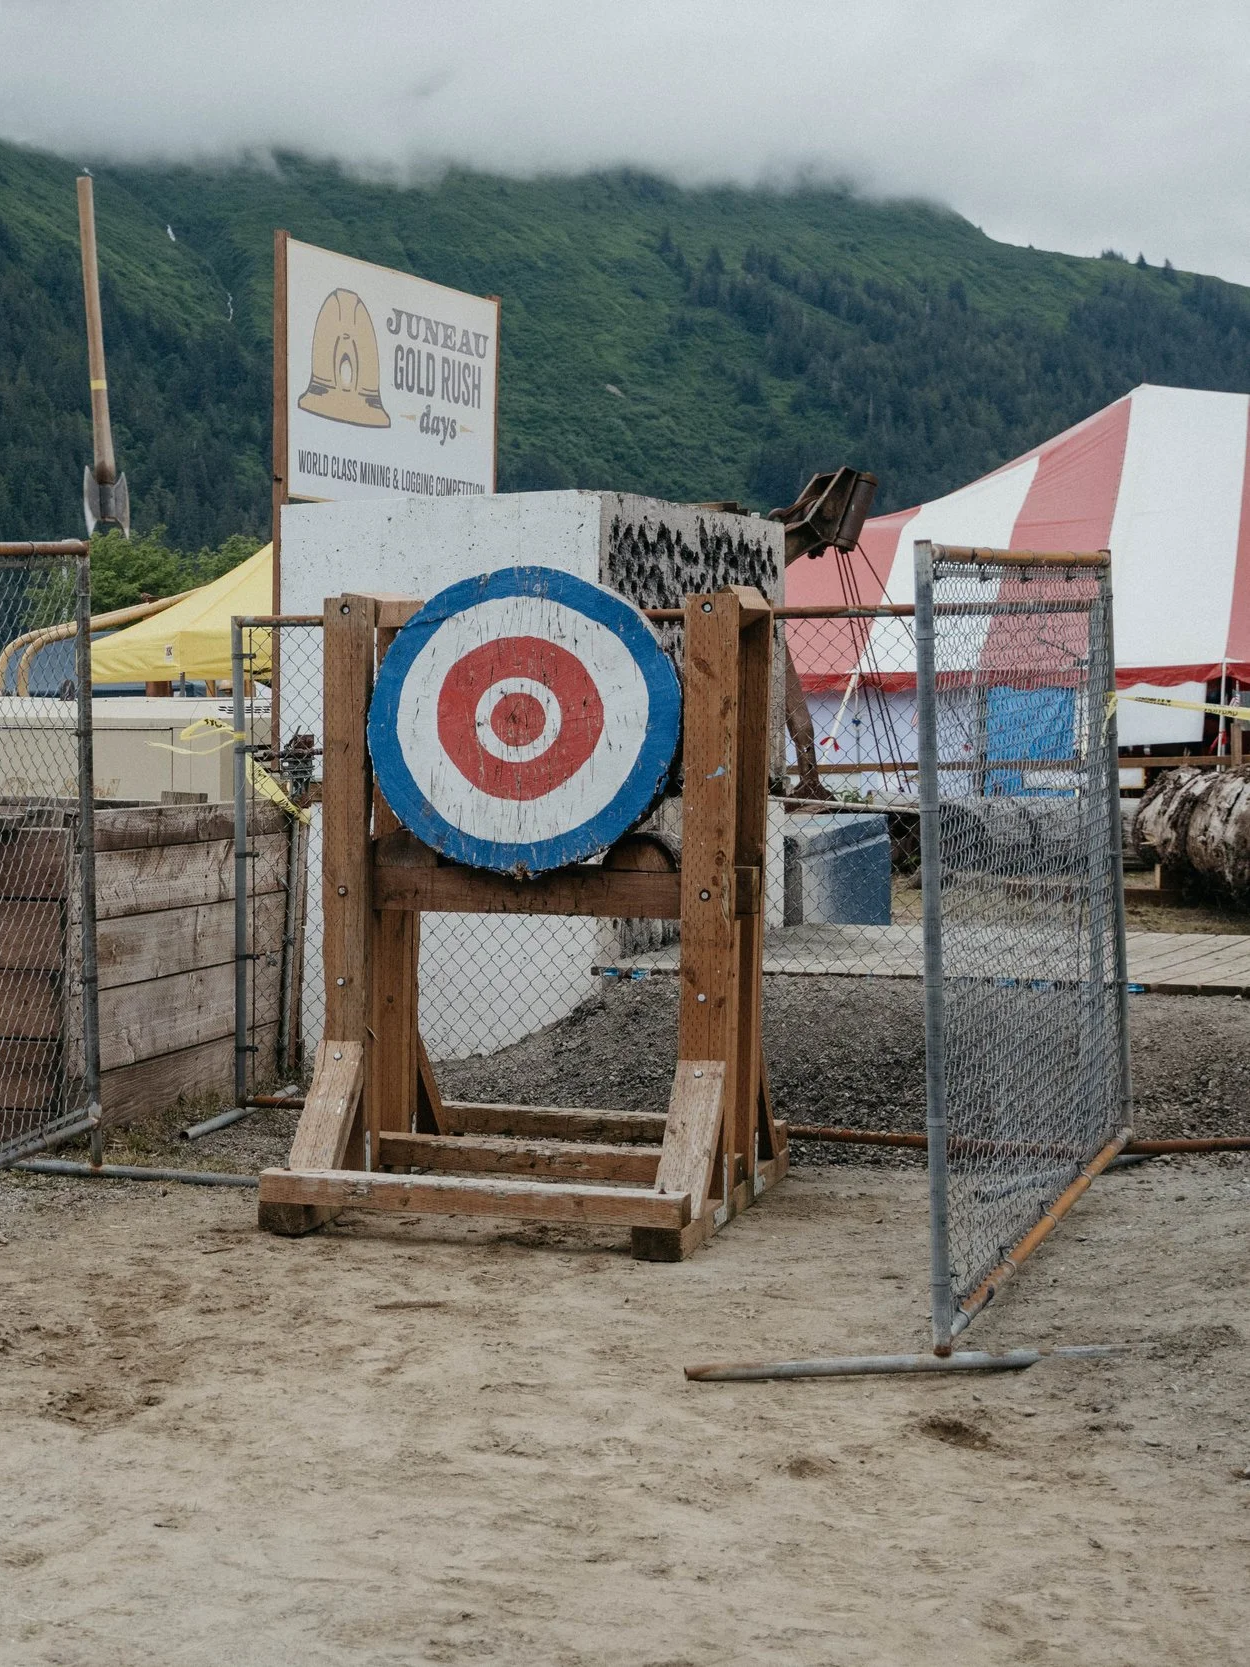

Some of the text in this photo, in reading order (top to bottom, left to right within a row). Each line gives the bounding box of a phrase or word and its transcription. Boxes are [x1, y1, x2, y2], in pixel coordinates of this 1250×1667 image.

[386, 307, 490, 359] JUNEAU
[393, 344, 482, 410] GOLD RUSH
[418, 404, 458, 446] days
[297, 449, 329, 477] WORLD
[330, 455, 358, 483] CLASS
[359, 461, 391, 489] MINING
[392, 467, 400, 490] &
[401, 467, 434, 496] LOGGING
